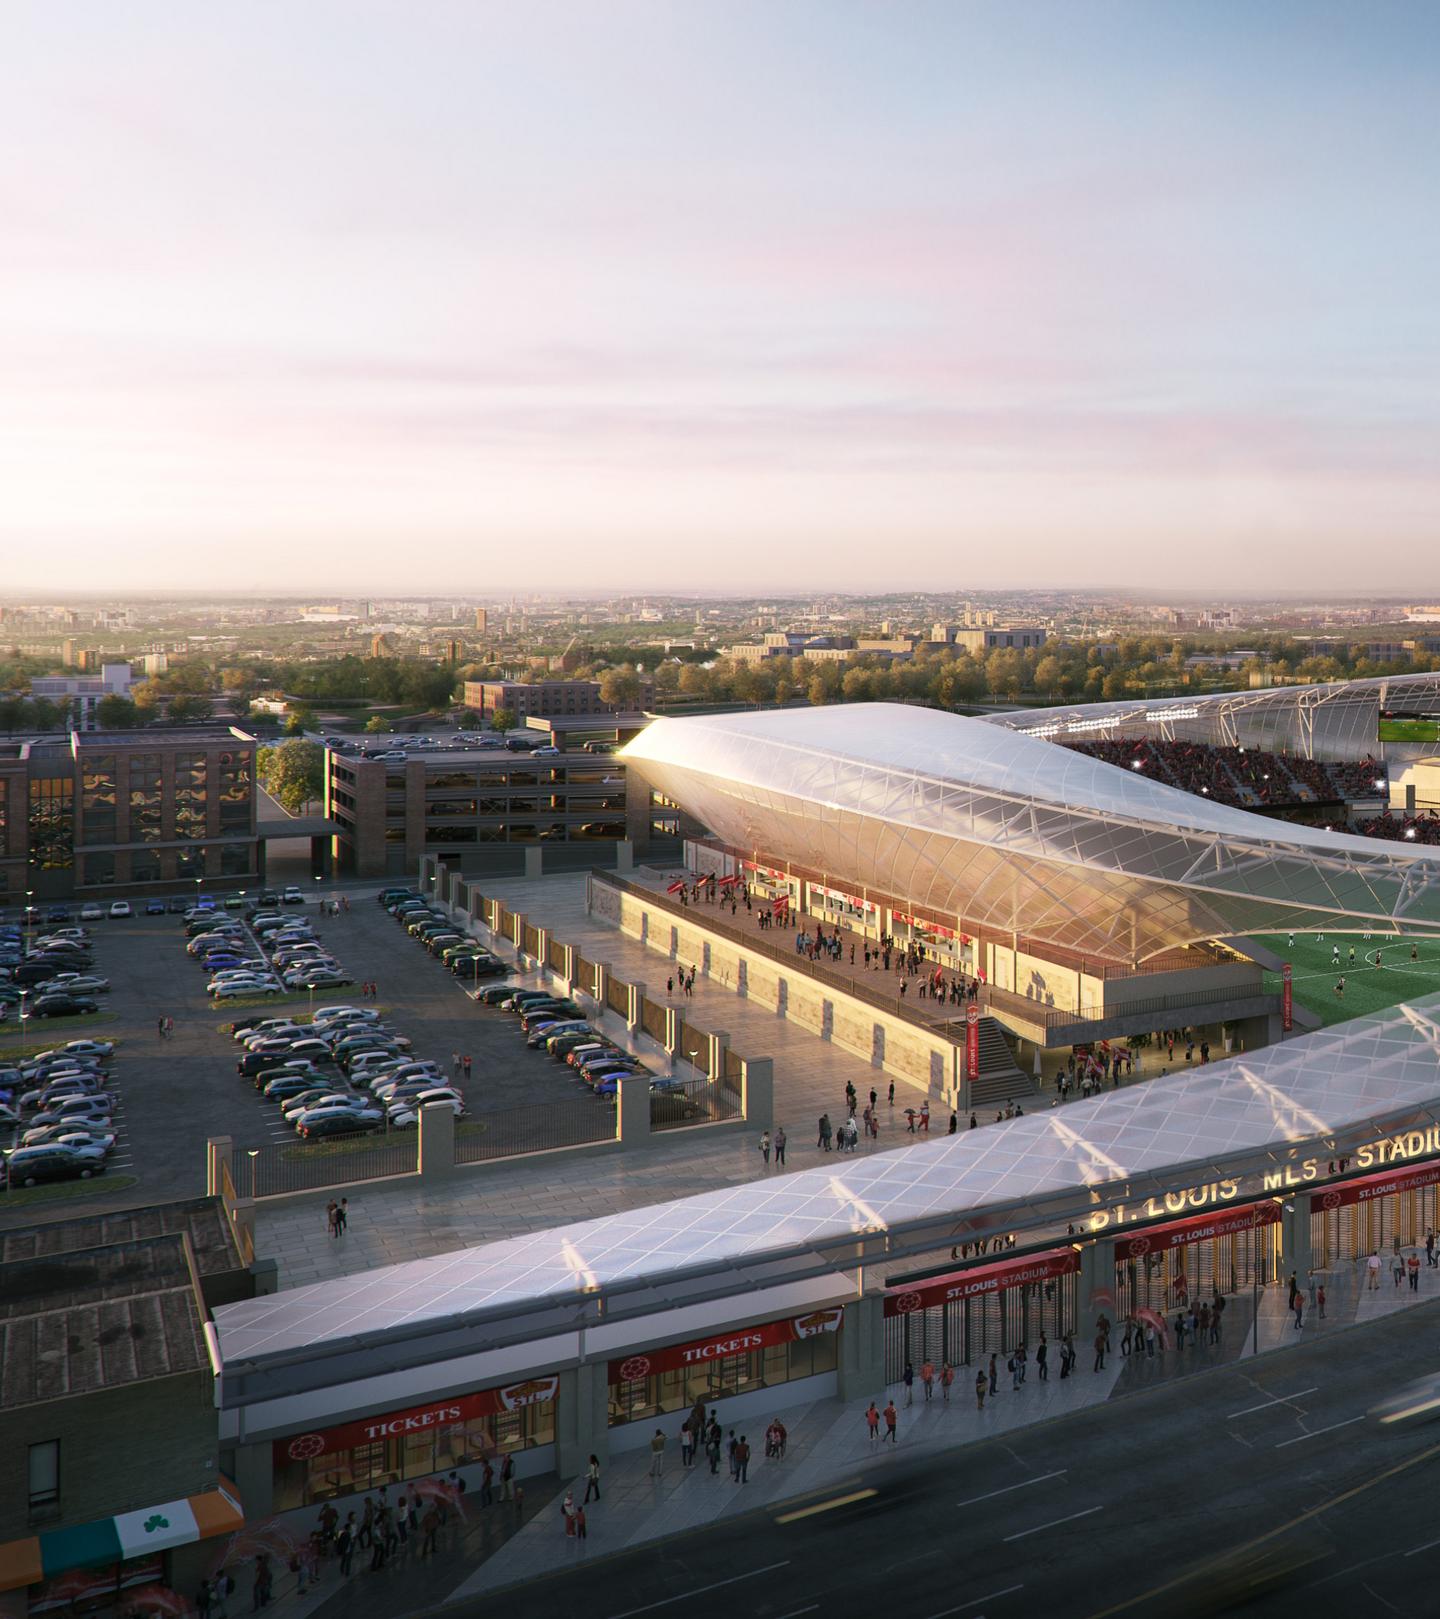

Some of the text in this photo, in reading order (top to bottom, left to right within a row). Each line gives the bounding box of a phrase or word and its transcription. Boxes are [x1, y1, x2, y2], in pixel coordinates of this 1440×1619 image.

[1147, 1178, 1239, 1217] LOUIS
[1263, 1158, 1318, 1190] MLS
[1359, 1172, 1440, 1199] ST. LOUIS STADIUM
[1171, 1235, 1185, 1245] ST.
[1186, 1226, 1215, 1241] LOUIS
[946, 1266, 1049, 1299] ST. LOUIS STADIUM
[683, 1334, 763, 1361] TICKETS
[364, 1406, 462, 1439] TICKETS
